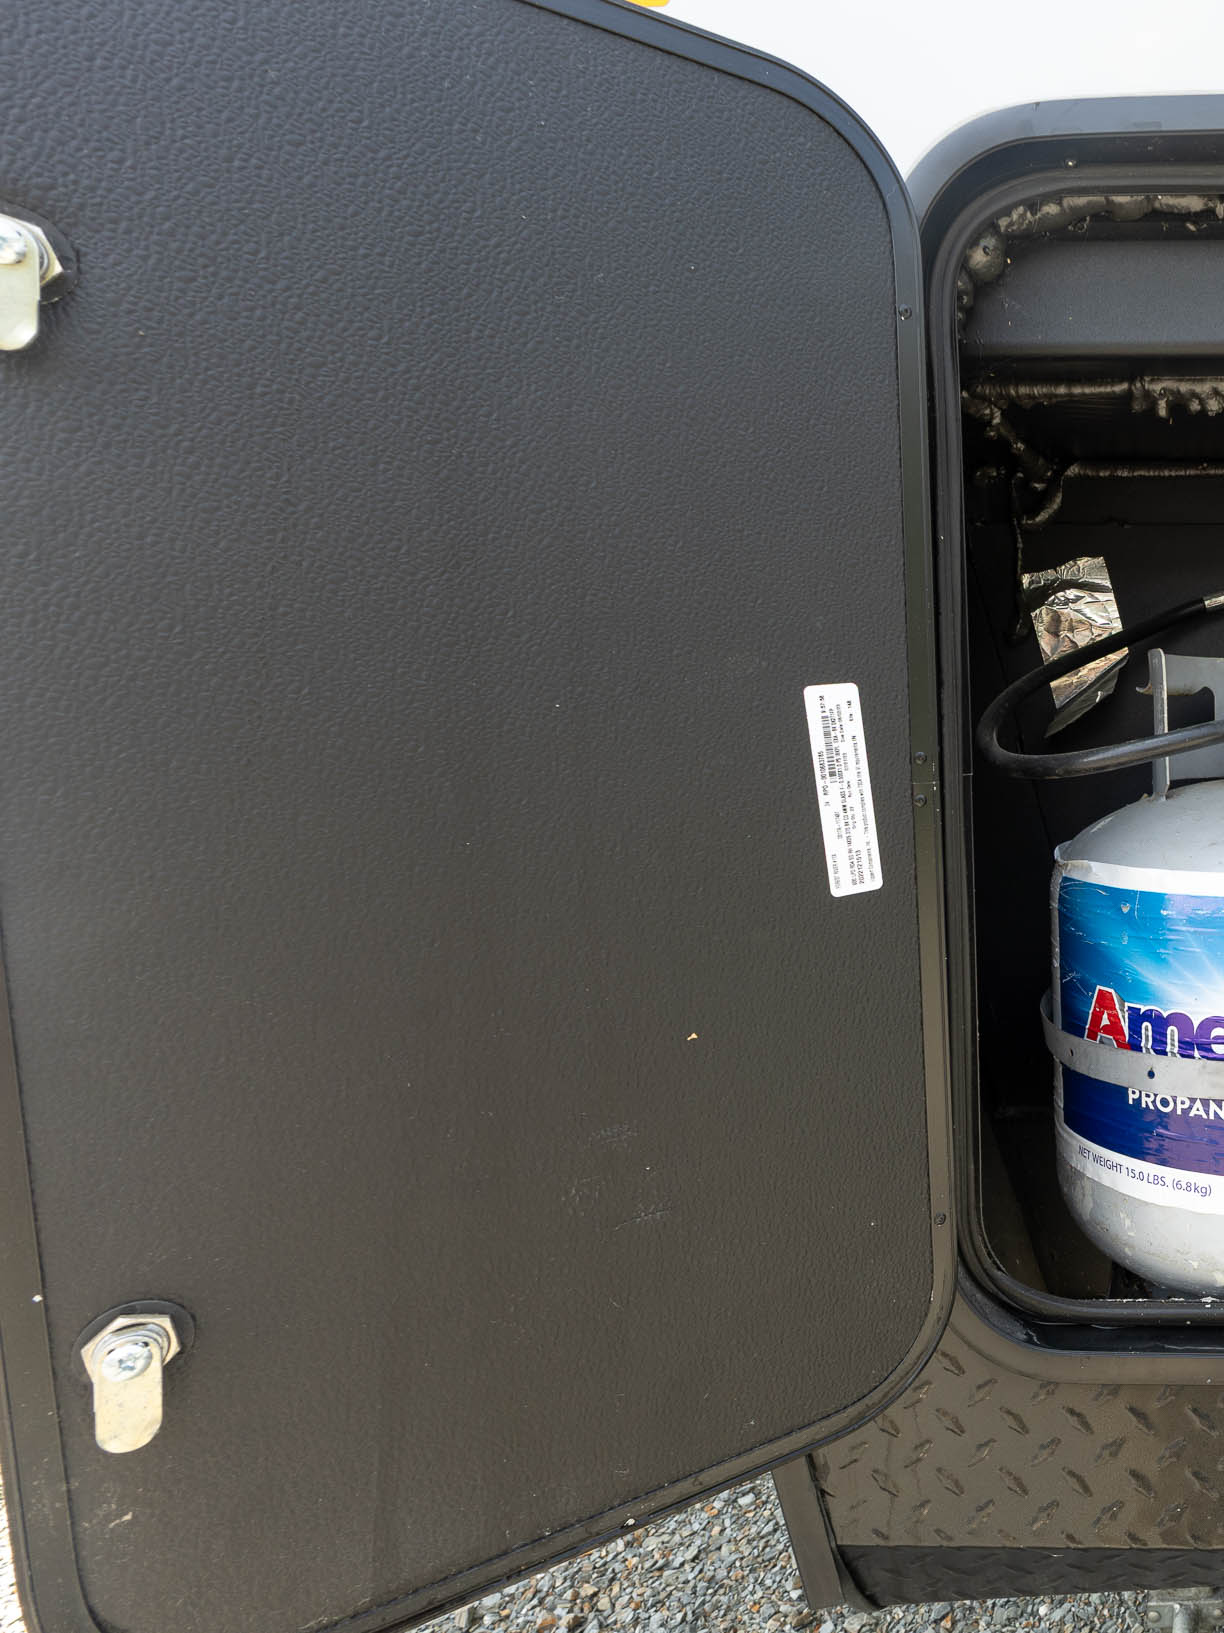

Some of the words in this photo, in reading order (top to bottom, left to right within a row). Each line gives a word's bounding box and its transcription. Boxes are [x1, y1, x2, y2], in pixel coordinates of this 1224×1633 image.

[1078, 1145, 1091, 1160] NET
[1092, 1153, 1123, 1174] WEIGHT
[1126, 1167, 1144, 1181] 15.0
[1147, 1173, 1168, 1187] LBS.
